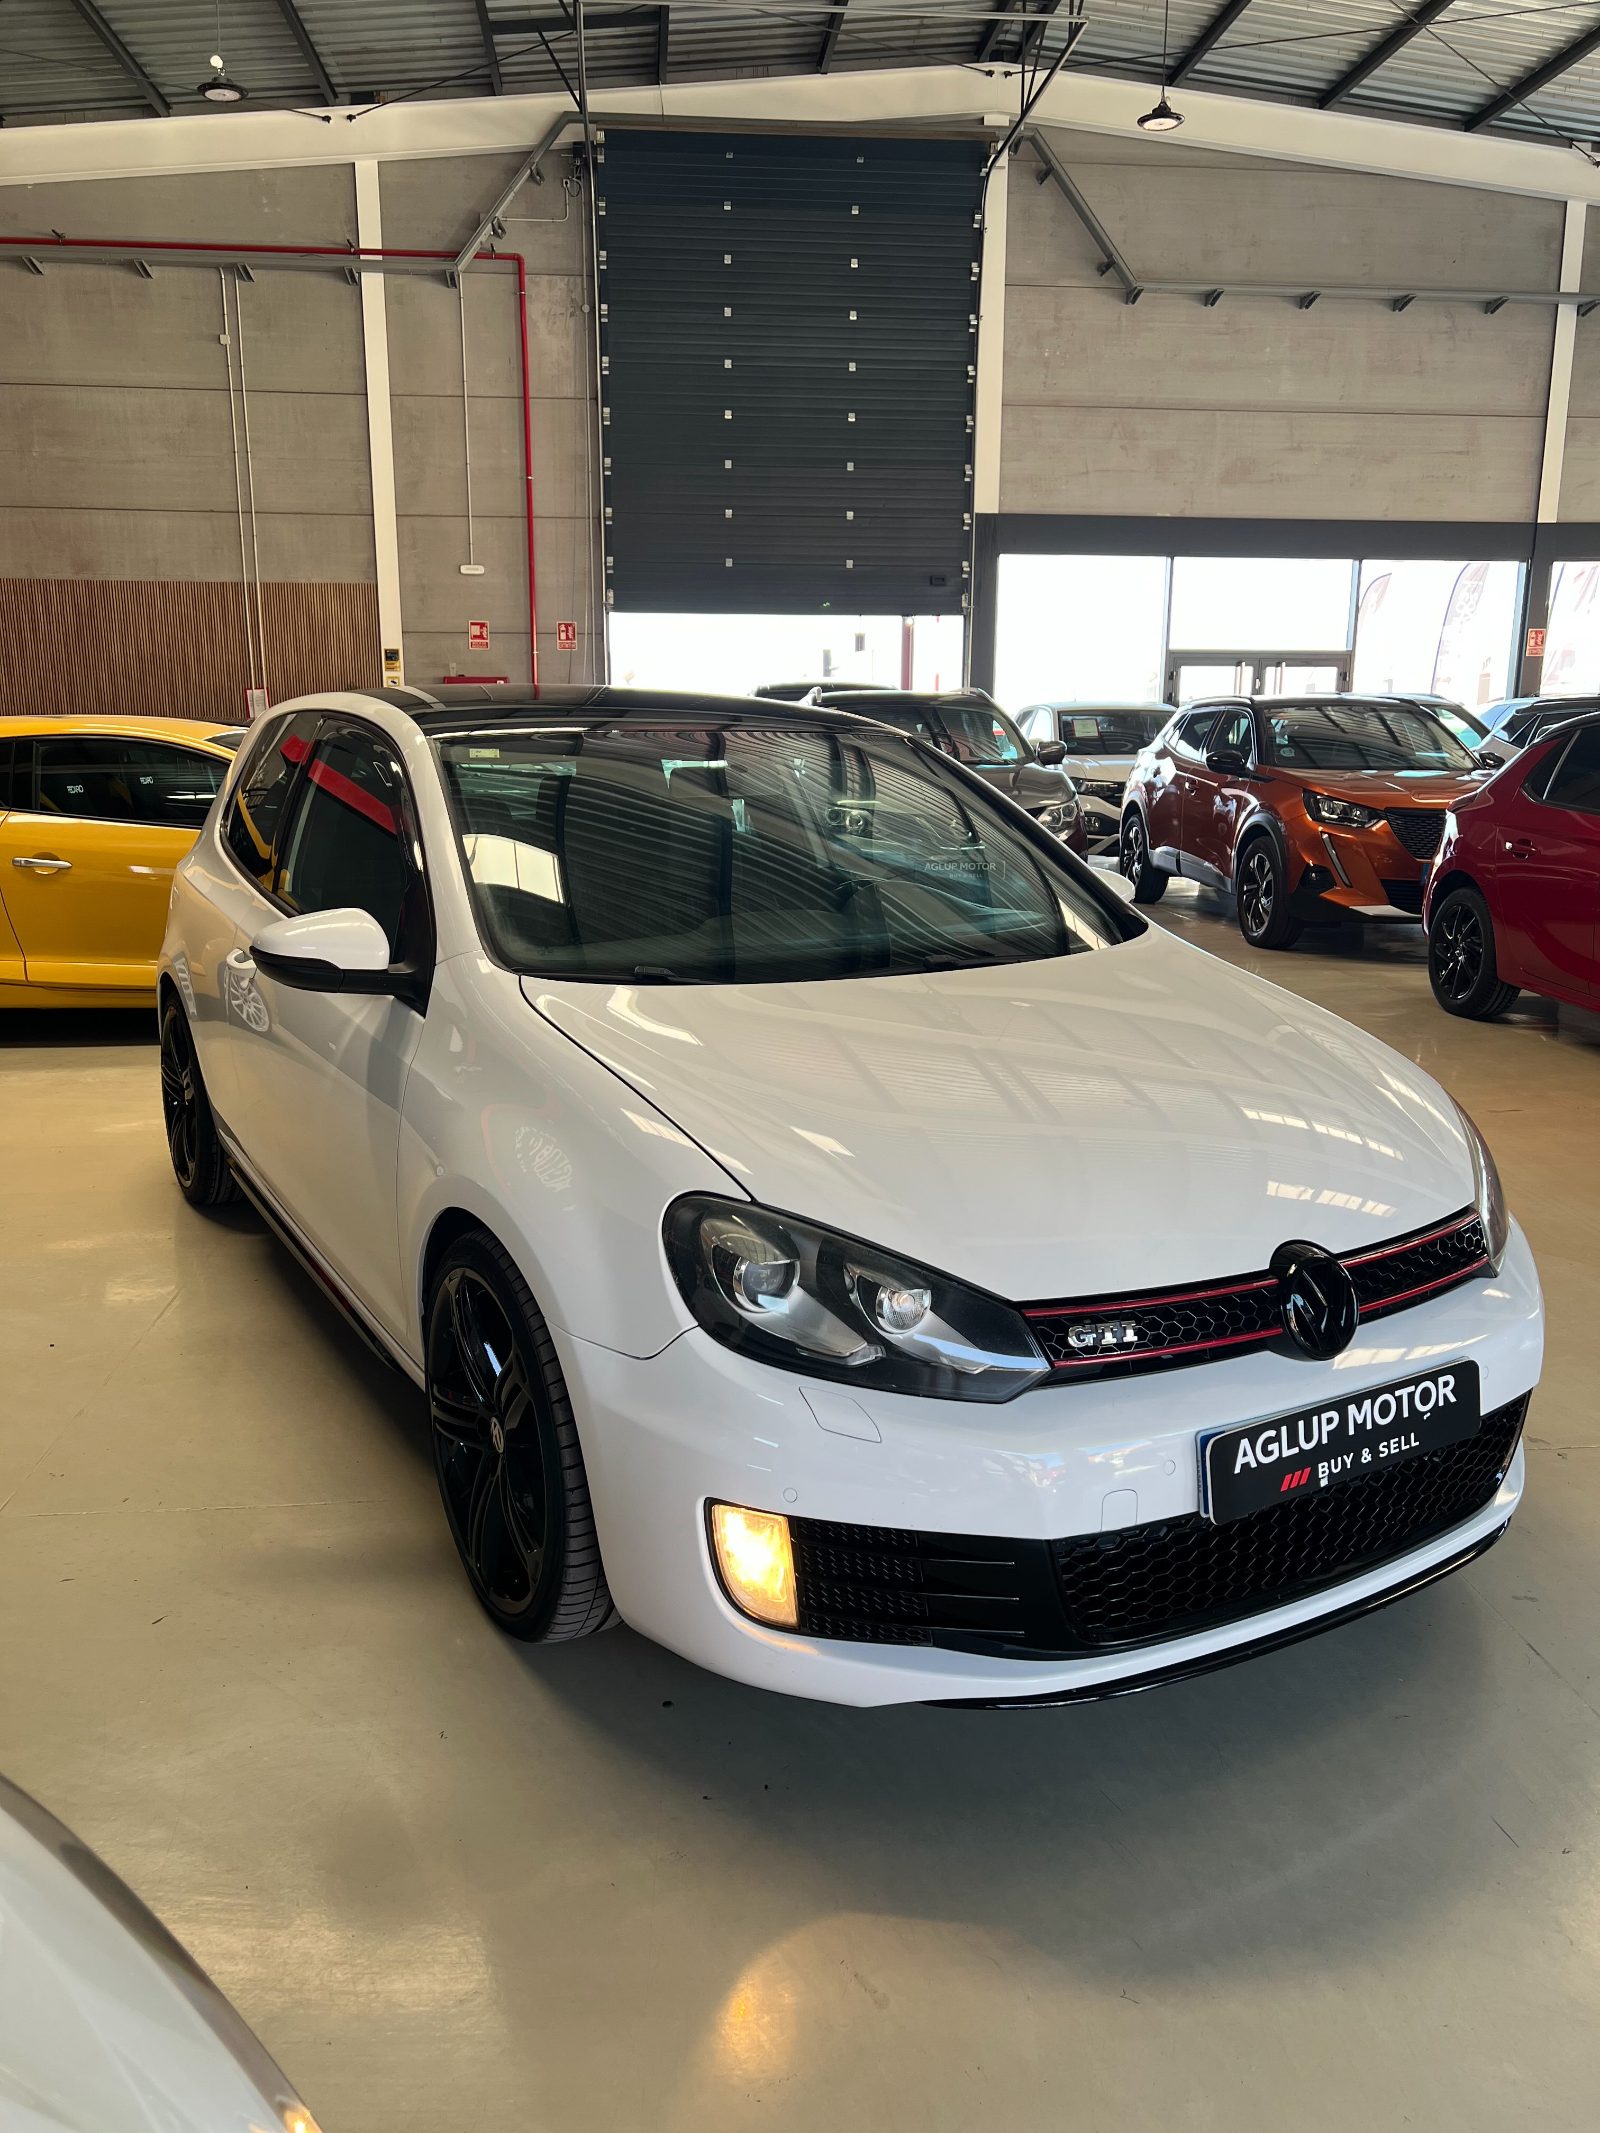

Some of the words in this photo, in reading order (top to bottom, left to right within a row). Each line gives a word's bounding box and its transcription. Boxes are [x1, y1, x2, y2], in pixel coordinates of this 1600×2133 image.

[1067, 1320, 1139, 1348] GTI
[1233, 1410, 1340, 1475] AGLUP
[1347, 1374, 1457, 1436] MOTOR
[1318, 1452, 1354, 1479] BUY
[1361, 1447, 1373, 1464] &
[1379, 1432, 1420, 1458] SELL
